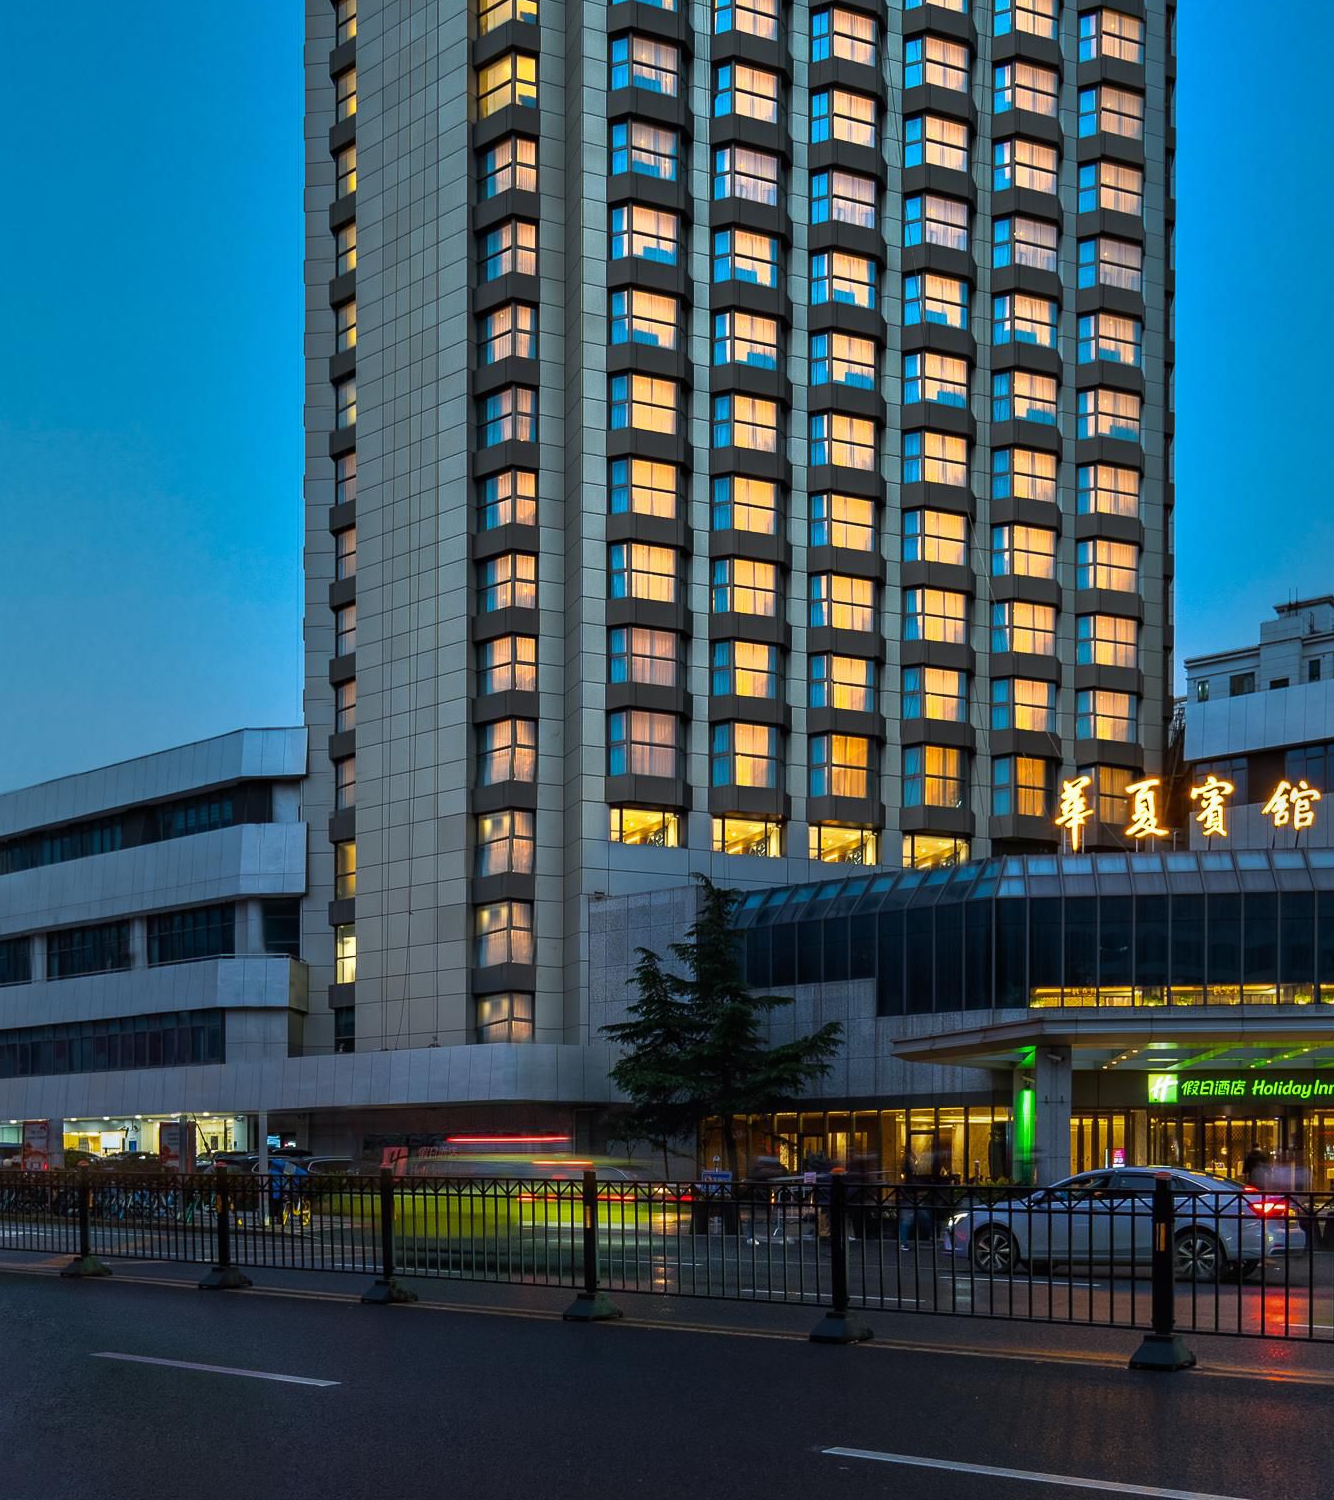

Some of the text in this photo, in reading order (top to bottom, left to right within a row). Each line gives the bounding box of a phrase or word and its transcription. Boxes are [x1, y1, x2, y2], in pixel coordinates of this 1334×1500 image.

[1181, 1080, 1246, 1096] 假日酒店
[1252, 1079, 1312, 1099] Holiday
